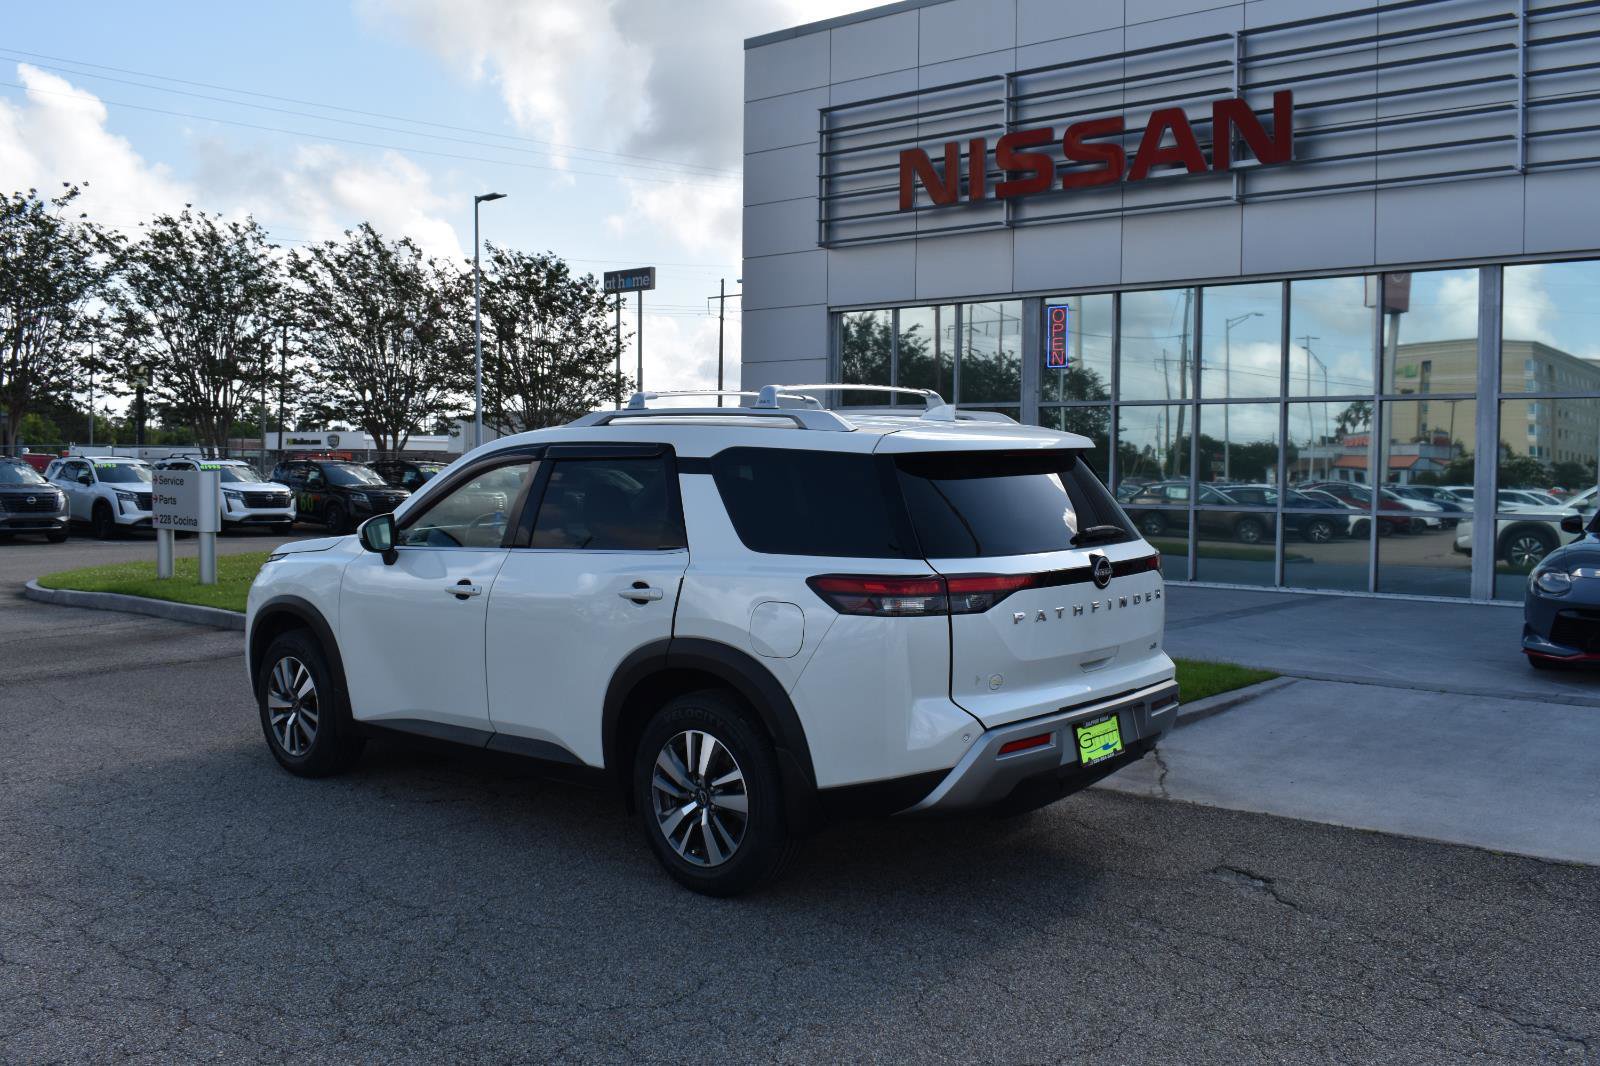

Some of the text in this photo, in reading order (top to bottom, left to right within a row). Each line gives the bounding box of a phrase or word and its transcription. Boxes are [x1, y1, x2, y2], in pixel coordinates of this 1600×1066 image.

[900, 89, 1293, 211] NISSAN
[604, 276, 616, 290] at
[1051, 308, 1066, 366] OPEN
[158, 475, 185, 486] Service
[158, 495, 177, 506] Parts
[159, 514, 198, 527] 228 Cocina
[1013, 589, 1161, 625] PATHFINDER
